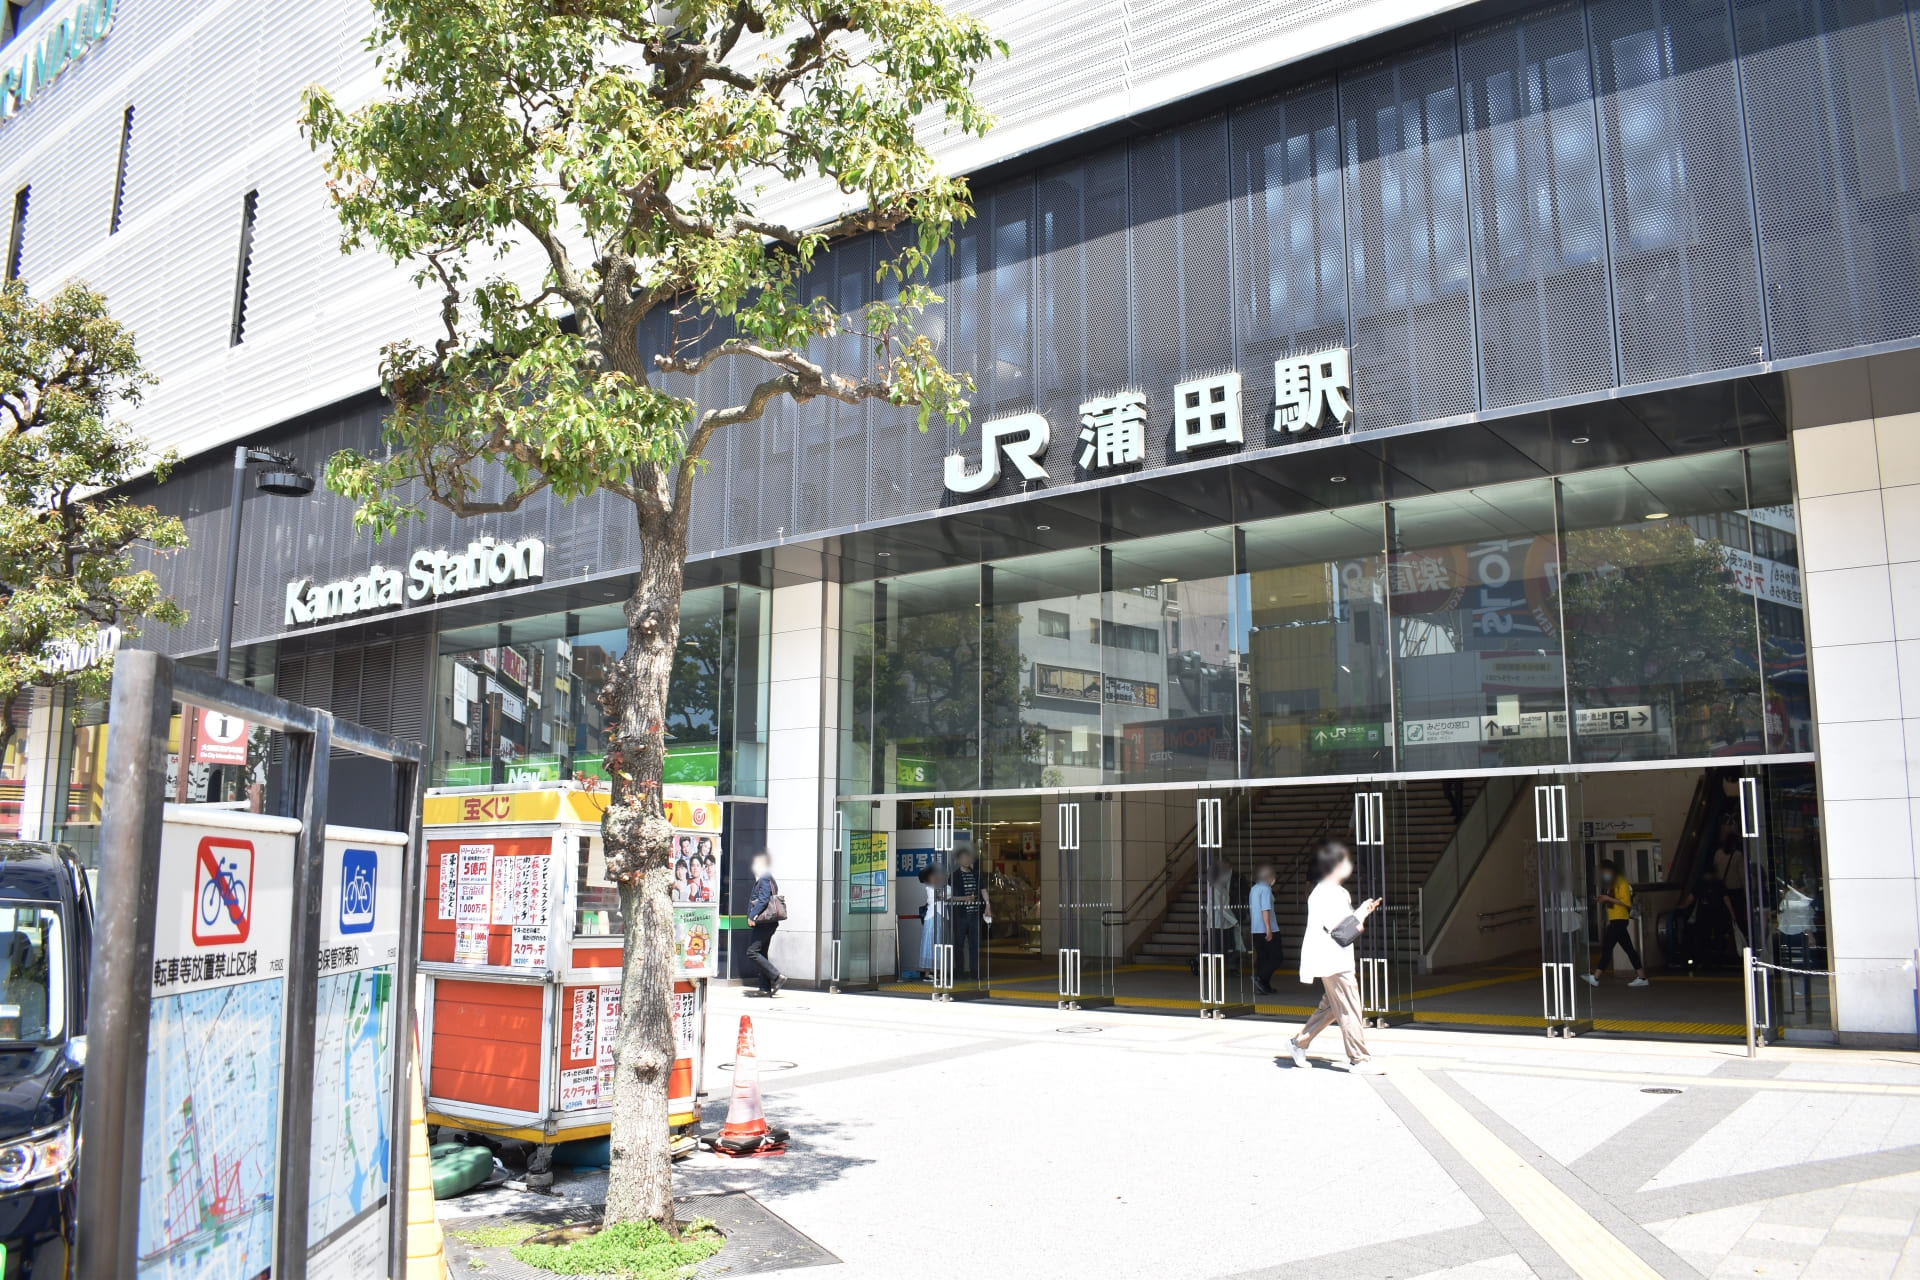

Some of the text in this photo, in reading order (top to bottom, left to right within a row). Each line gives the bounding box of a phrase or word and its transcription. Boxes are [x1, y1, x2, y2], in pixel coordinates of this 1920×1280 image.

[944, 346, 1354, 494] JR 蒲田駅
[284, 536, 545, 626] Kamata Station
[1330, 727, 1346, 738] JR
[1426, 721, 1470, 730] みどりの窓口
[508, 767, 542, 784] New
[463, 796, 510, 821] 宝くじ
[1595, 821, 1634, 831] エレベーター
[464, 862, 487, 876] 5億円
[514, 944, 545, 955] スクラッチ
[153, 950, 284, 988] 転車等放置禁止区域 大田区
